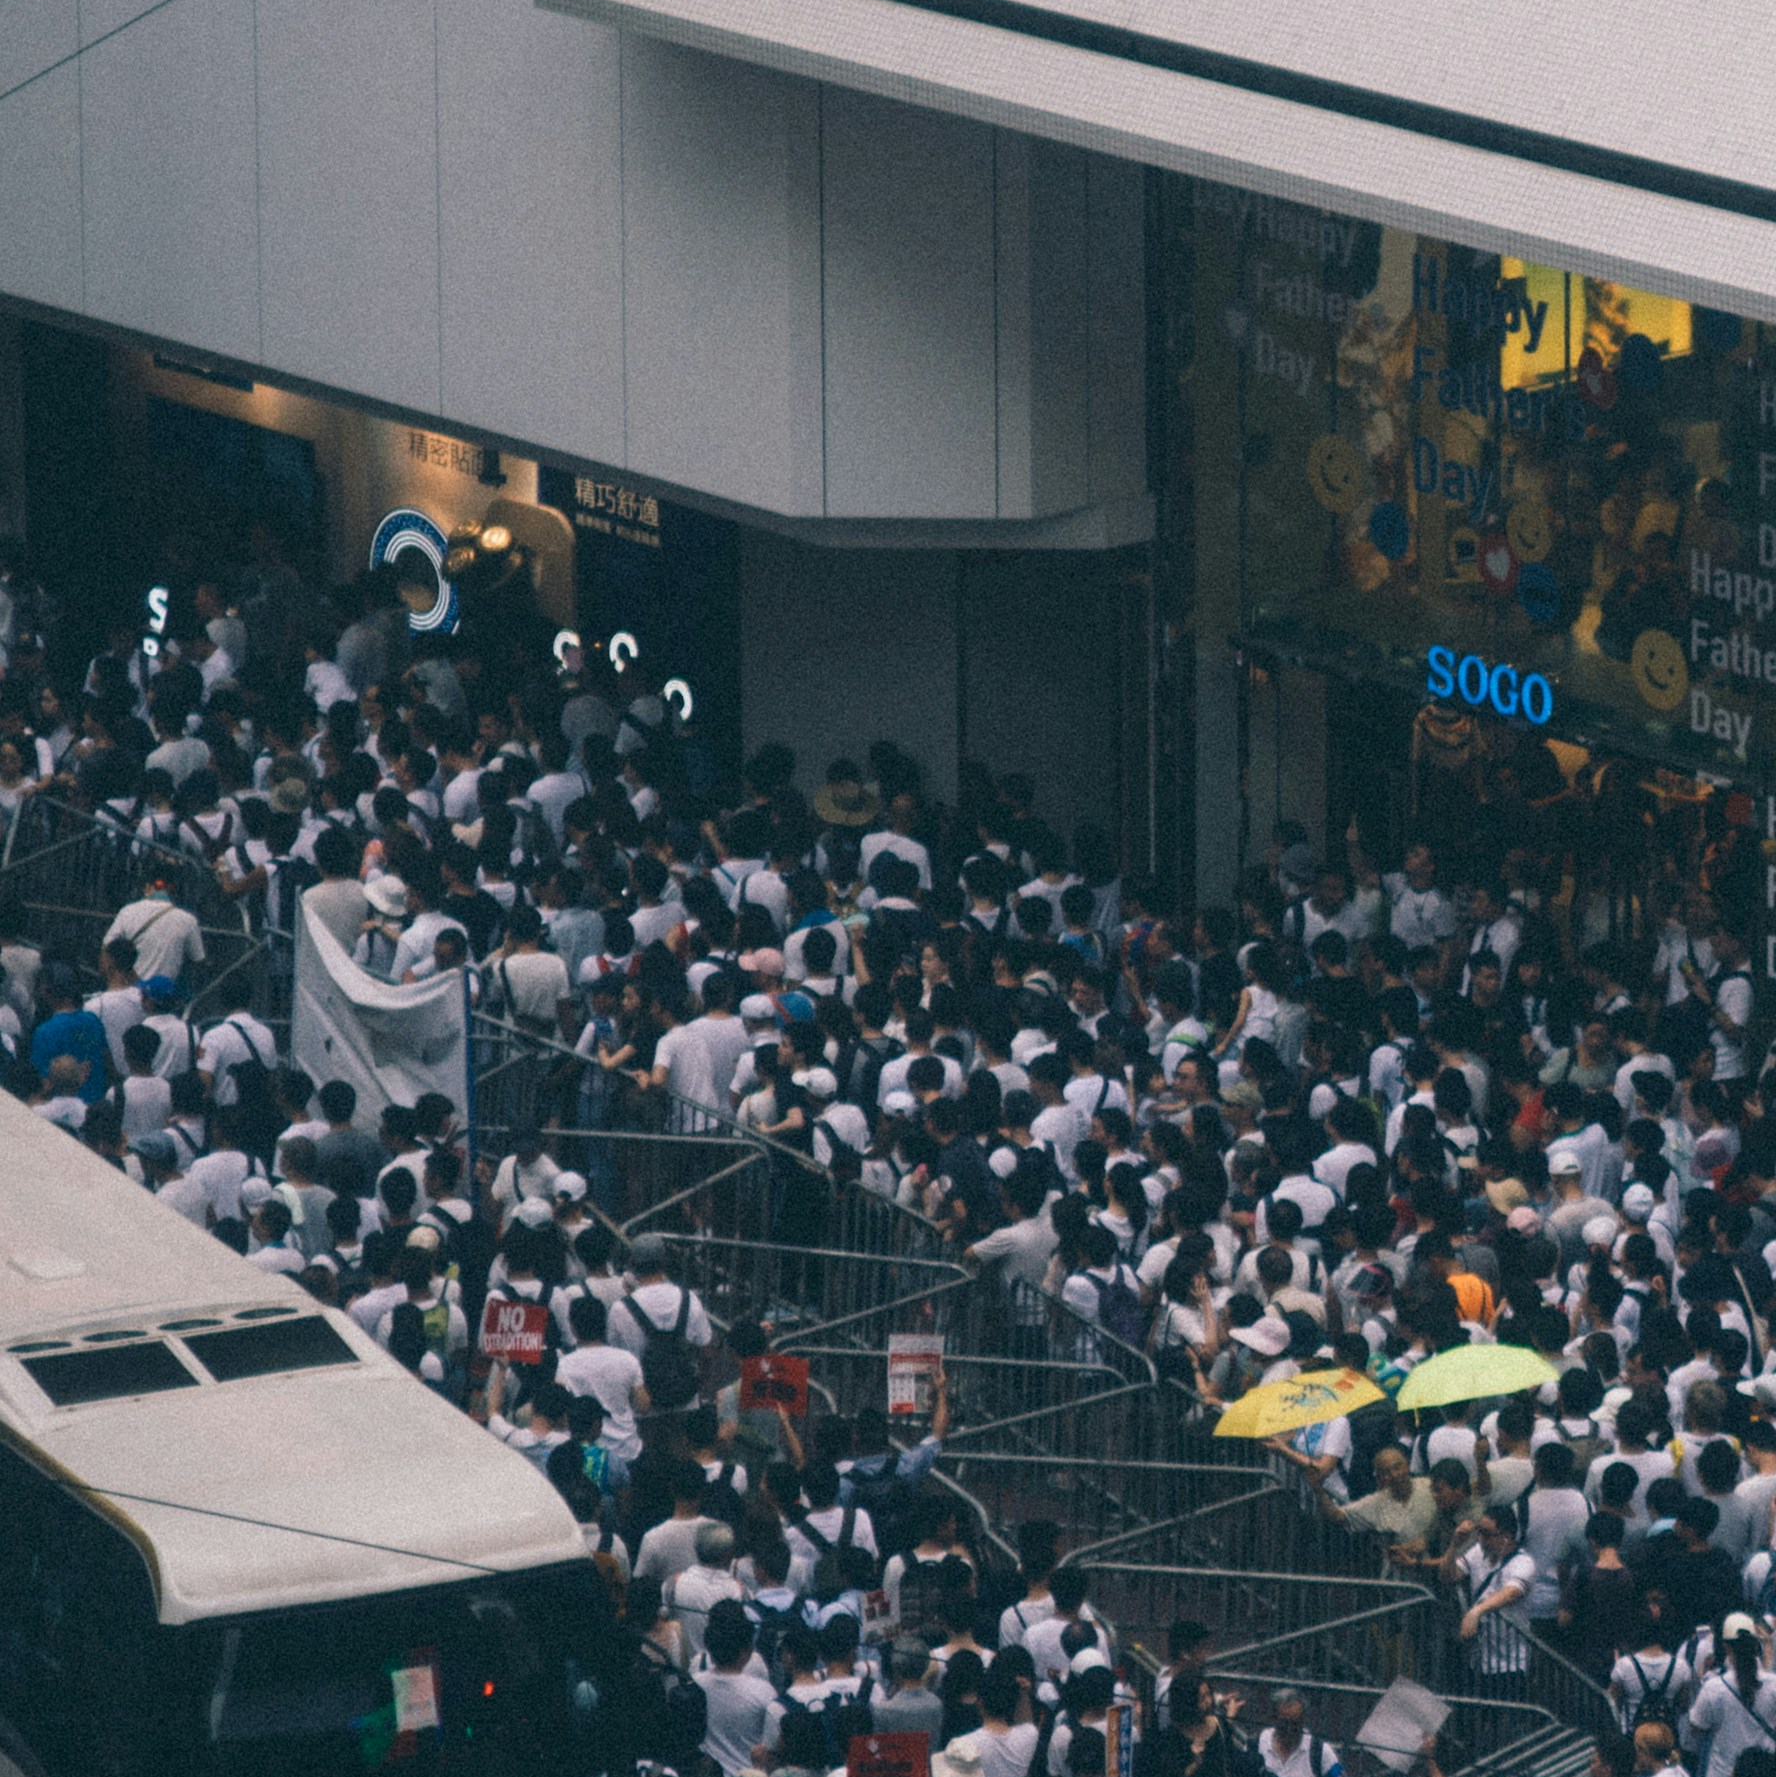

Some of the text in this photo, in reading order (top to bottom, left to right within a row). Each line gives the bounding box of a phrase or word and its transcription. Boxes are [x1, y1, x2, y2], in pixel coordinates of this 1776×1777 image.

[1412, 252, 1548, 352] Happy
[1413, 437, 1495, 524] Day
[1427, 645, 1552, 726] SOGO
[1690, 688, 1753, 760] Day
[497, 1307, 526, 1333] NO
